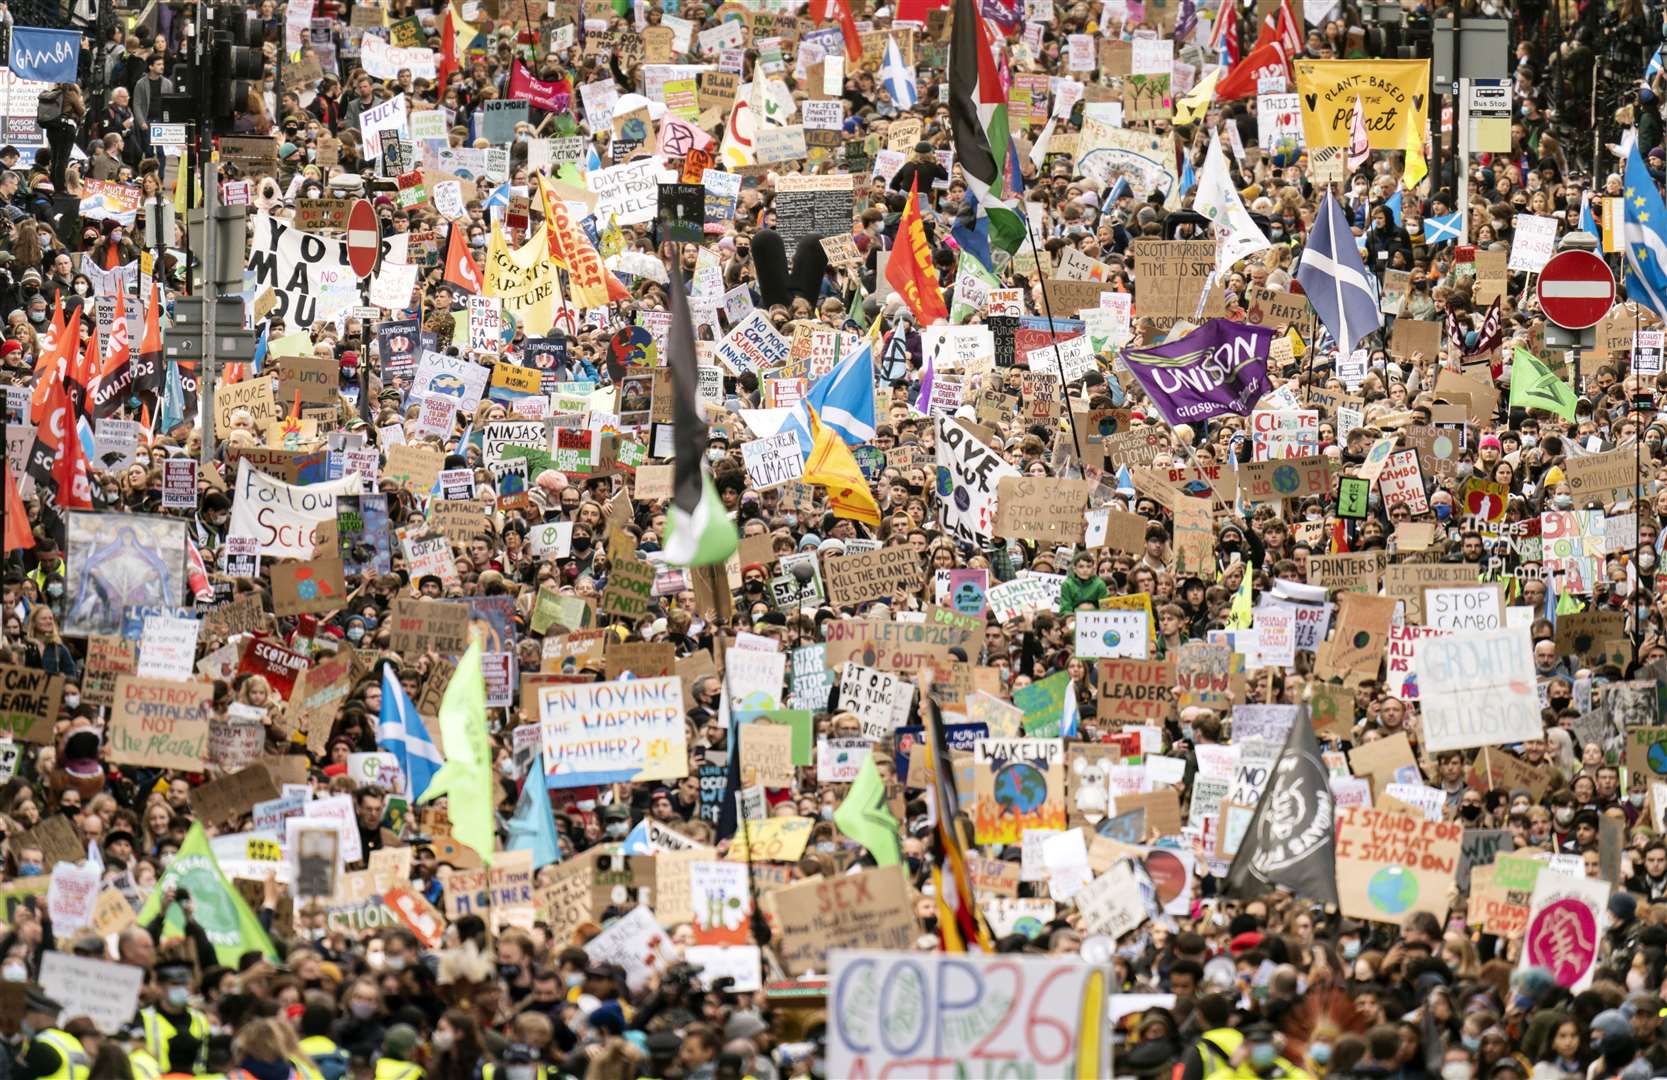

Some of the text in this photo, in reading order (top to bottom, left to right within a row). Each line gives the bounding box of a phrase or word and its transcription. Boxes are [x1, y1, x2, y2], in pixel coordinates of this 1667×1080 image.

[16, 40, 73, 69] GAMBA
[707, 73, 733, 86] BLAH
[1325, 75, 1405, 103] PLANT-BASED
[504, 102, 527, 110] MORE
[1264, 99, 1288, 109] THIS
[364, 102, 401, 126] FUCK
[1276, 114, 1299, 127] NOT
[593, 164, 651, 188] DIVEST
[626, 175, 658, 193] FOSSIL
[600, 194, 657, 218] FUELS
[1136, 243, 1168, 257] SCOTT
[1067, 255, 1089, 271] Less
[1141, 263, 1187, 276] TIME TO
[321, 271, 337, 282] NO
[990, 291, 1018, 300] TIME
[1054, 285, 1081, 296] FUCK
[1256, 290, 1275, 301] FOR
[990, 303, 1005, 313] HAS
[1270, 303, 1302, 319] PEATS
[471, 319, 497, 327] FUELS
[753, 317, 790, 356] NO MORE
[740, 353, 750, 361] OF
[1064, 350, 1080, 361] BAD
[1151, 333, 1258, 394] UNISON
[219, 384, 265, 407] NO MORE
[935, 384, 961, 392] SOCIALIST
[488, 425, 538, 439] NINJAS
[559, 450, 578, 458] FUND
[939, 418, 1000, 476] LOVE
[762, 451, 780, 462] FOR
[746, 455, 802, 487] KLIMATET
[1169, 466, 1220, 481] BE THE
[1381, 466, 1417, 481] CAMBO
[1396, 481, 1405, 489] U
[1385, 488, 1424, 505] FOSSIL
[1009, 505, 1041, 516] STOP
[1544, 513, 1603, 539] SAVE
[831, 557, 871, 574] NOOO
[1311, 560, 1374, 577] PAINTERS
[832, 562, 917, 588] KILL THE PLANET
[1392, 571, 1401, 580] IF
[852, 580, 894, 600] SO SEXY
[990, 581, 1041, 600] CLIMATE
[994, 591, 1043, 611] JUSTICE
[1436, 593, 1489, 612] STOP
[428, 622, 459, 634] HAVE
[875, 624, 900, 640] LET
[416, 636, 427, 647] BE
[431, 639, 461, 648] HERE
[255, 643, 309, 671] SCOTLAND
[794, 647, 824, 661] STOP
[1104, 664, 1167, 681] TRUE
[5, 671, 49, 691] CAN'T
[794, 674, 826, 689] STOP
[1179, 674, 1228, 690] NOW
[126, 684, 199, 703] DESTROY
[1103, 685, 1173, 700] LEADERS
[125, 703, 208, 720] CAPITALISM
[142, 719, 176, 733] NOT
[982, 744, 1056, 760] WAKE UP
[1239, 768, 1266, 786] NO
[1344, 808, 1462, 842] I STAND FOR
[1373, 831, 1433, 848] WHAT
[1338, 840, 1452, 872] I STAND ON
[816, 875, 871, 912] SEX
[836, 958, 1077, 1064] COP26
